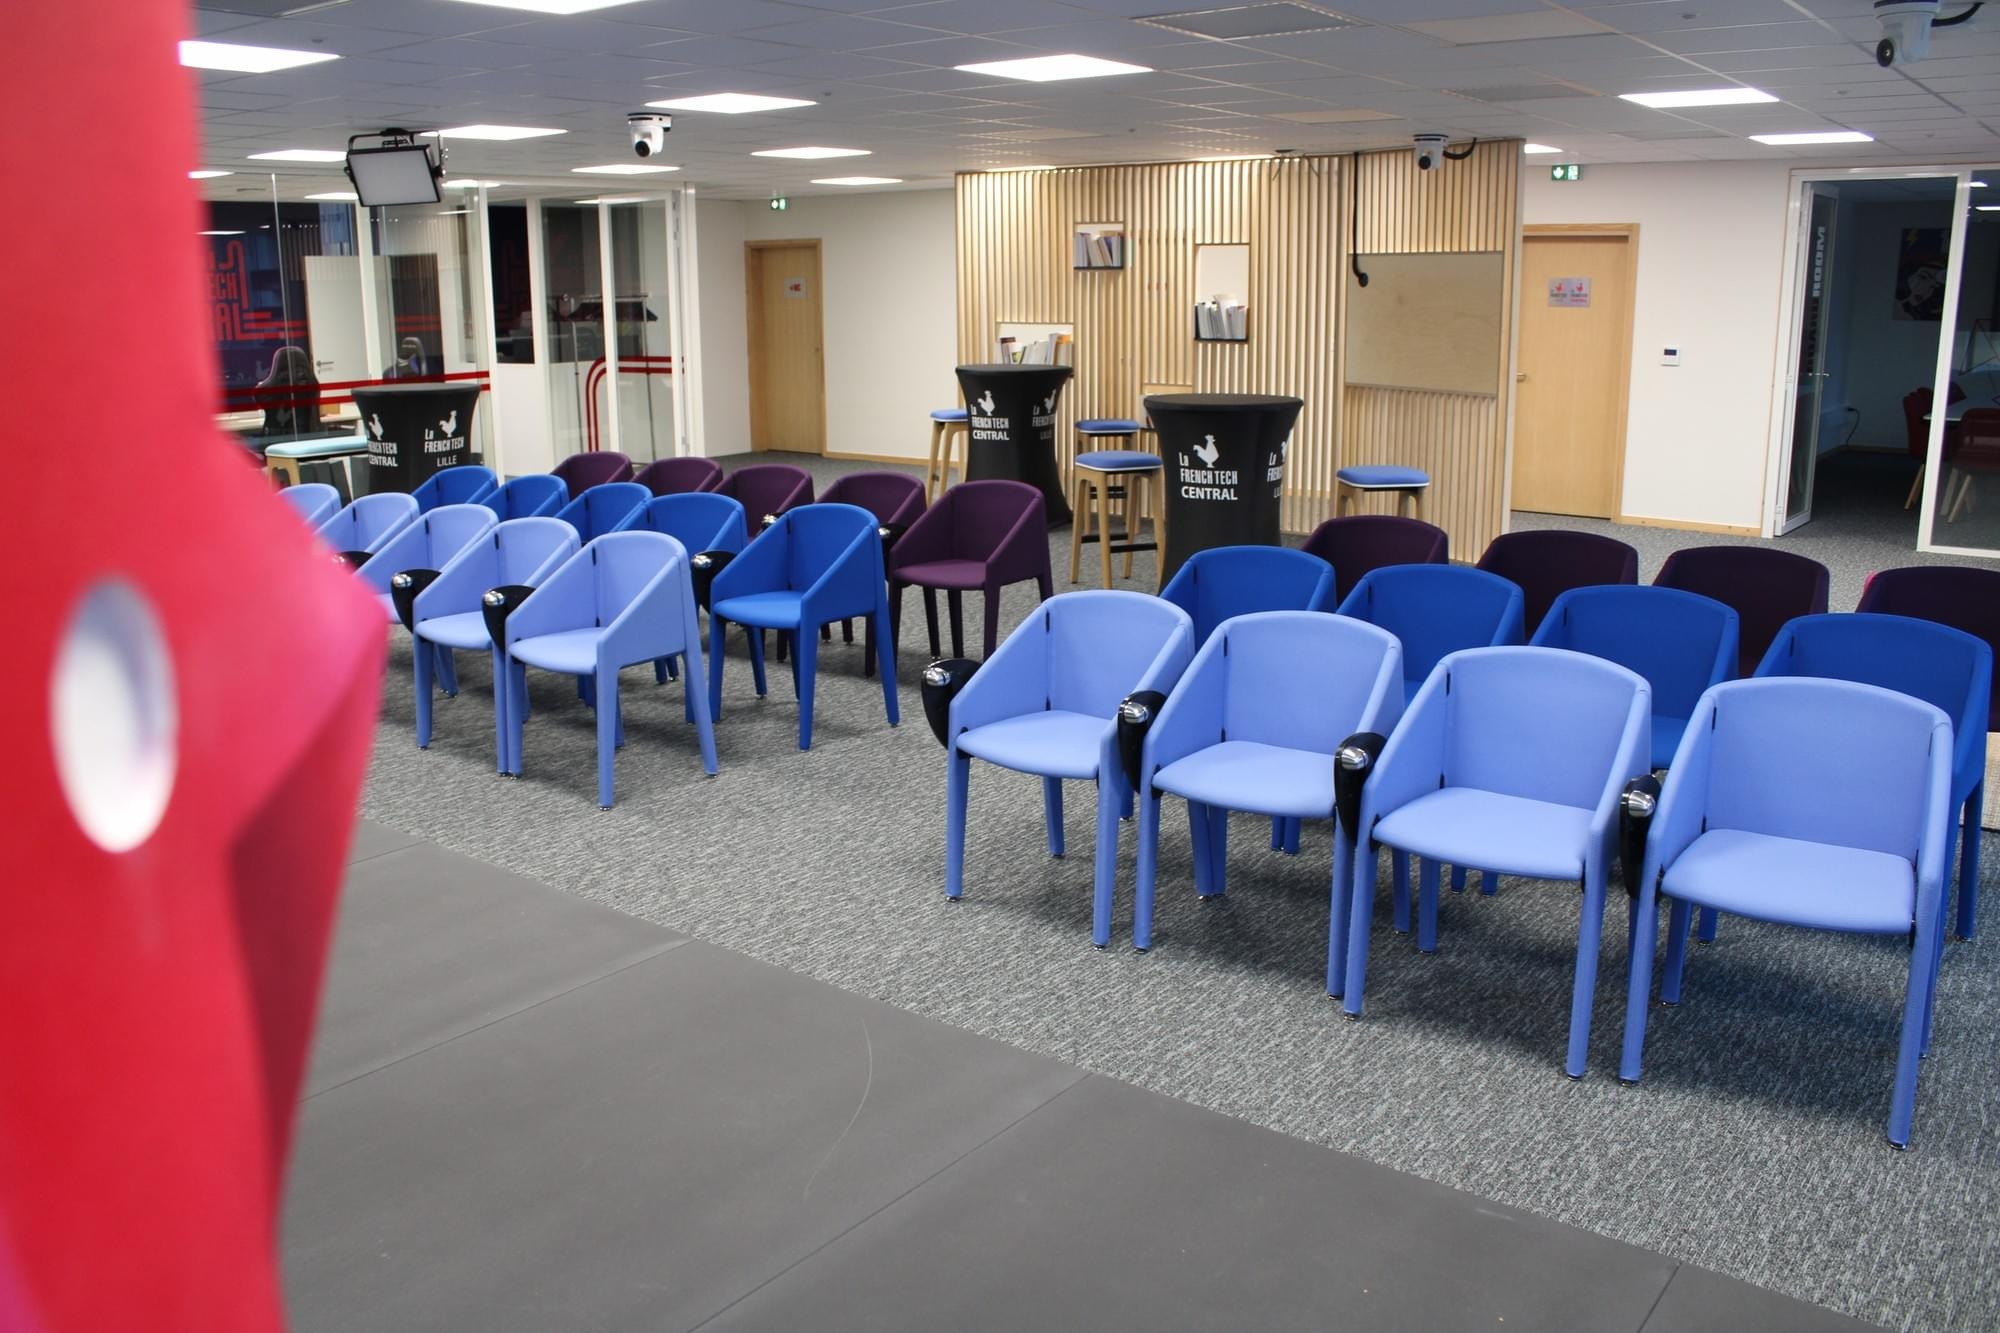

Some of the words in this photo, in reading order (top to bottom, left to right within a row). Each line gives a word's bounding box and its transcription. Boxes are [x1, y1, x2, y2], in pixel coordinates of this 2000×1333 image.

[992, 417, 1009, 429] TECH
[972, 429, 1010, 441] CENTRAL
[424, 439, 450, 453] FRENCH
[450, 436, 464, 450] TECH
[437, 455, 457, 467] LILLE
[1179, 452, 1189, 466] La
[1180, 468, 1213, 484] FRENCH
[1214, 470, 1238, 485] TECH
[1181, 486, 1239, 500] CENTRAL
